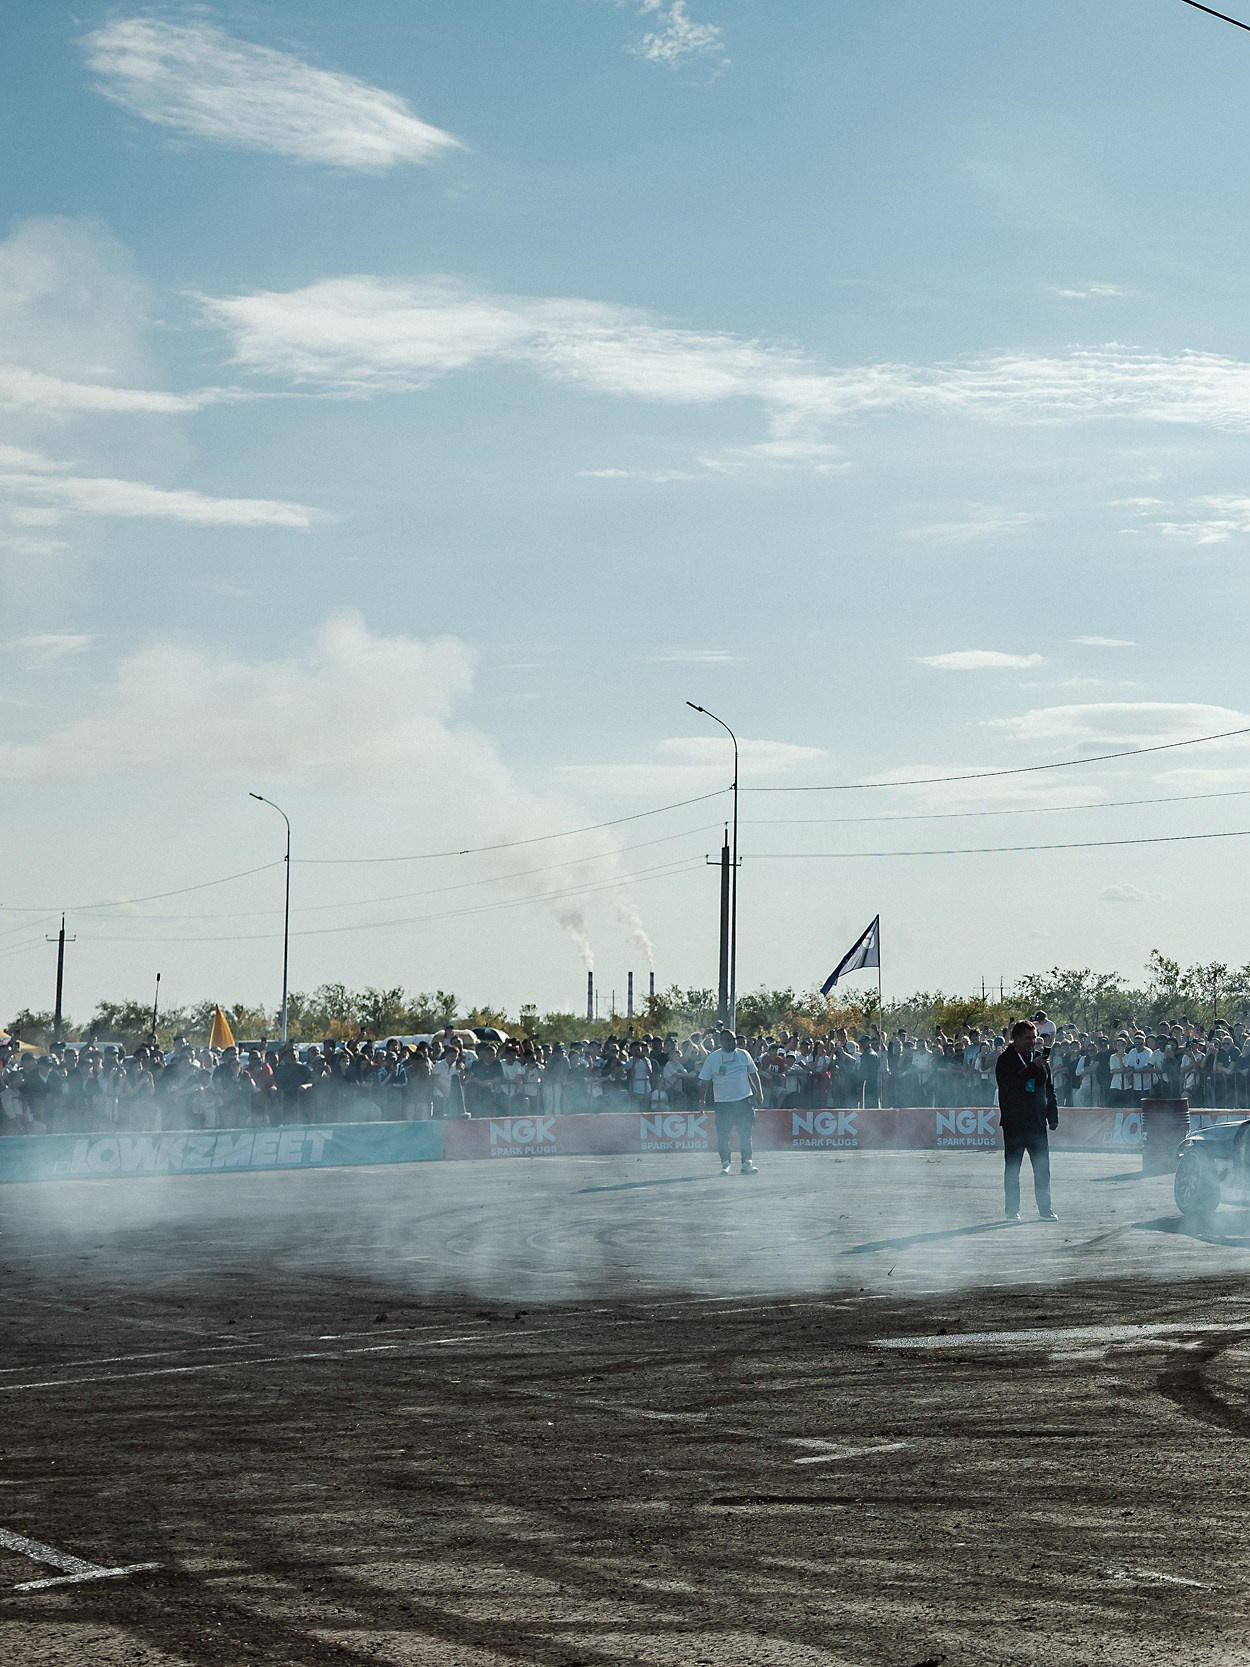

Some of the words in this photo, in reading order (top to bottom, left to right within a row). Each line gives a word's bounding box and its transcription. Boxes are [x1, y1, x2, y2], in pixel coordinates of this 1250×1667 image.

[489, 1116, 557, 1146] NGK
[639, 1114, 709, 1140] NGK
[791, 1111, 858, 1137] NGK
[936, 1110, 996, 1135] NGK
[490, 1147, 524, 1156] SPARK
[525, 1145, 557, 1154] PLUGS
[640, 1141, 673, 1150] SPARK
[675, 1140, 708, 1150] PLUGS
[792, 1138, 824, 1146] SPARK
[826, 1138, 858, 1146] PLUGS
[936, 1137, 965, 1146] SPARK
[967, 1137, 996, 1146] PLUGS
